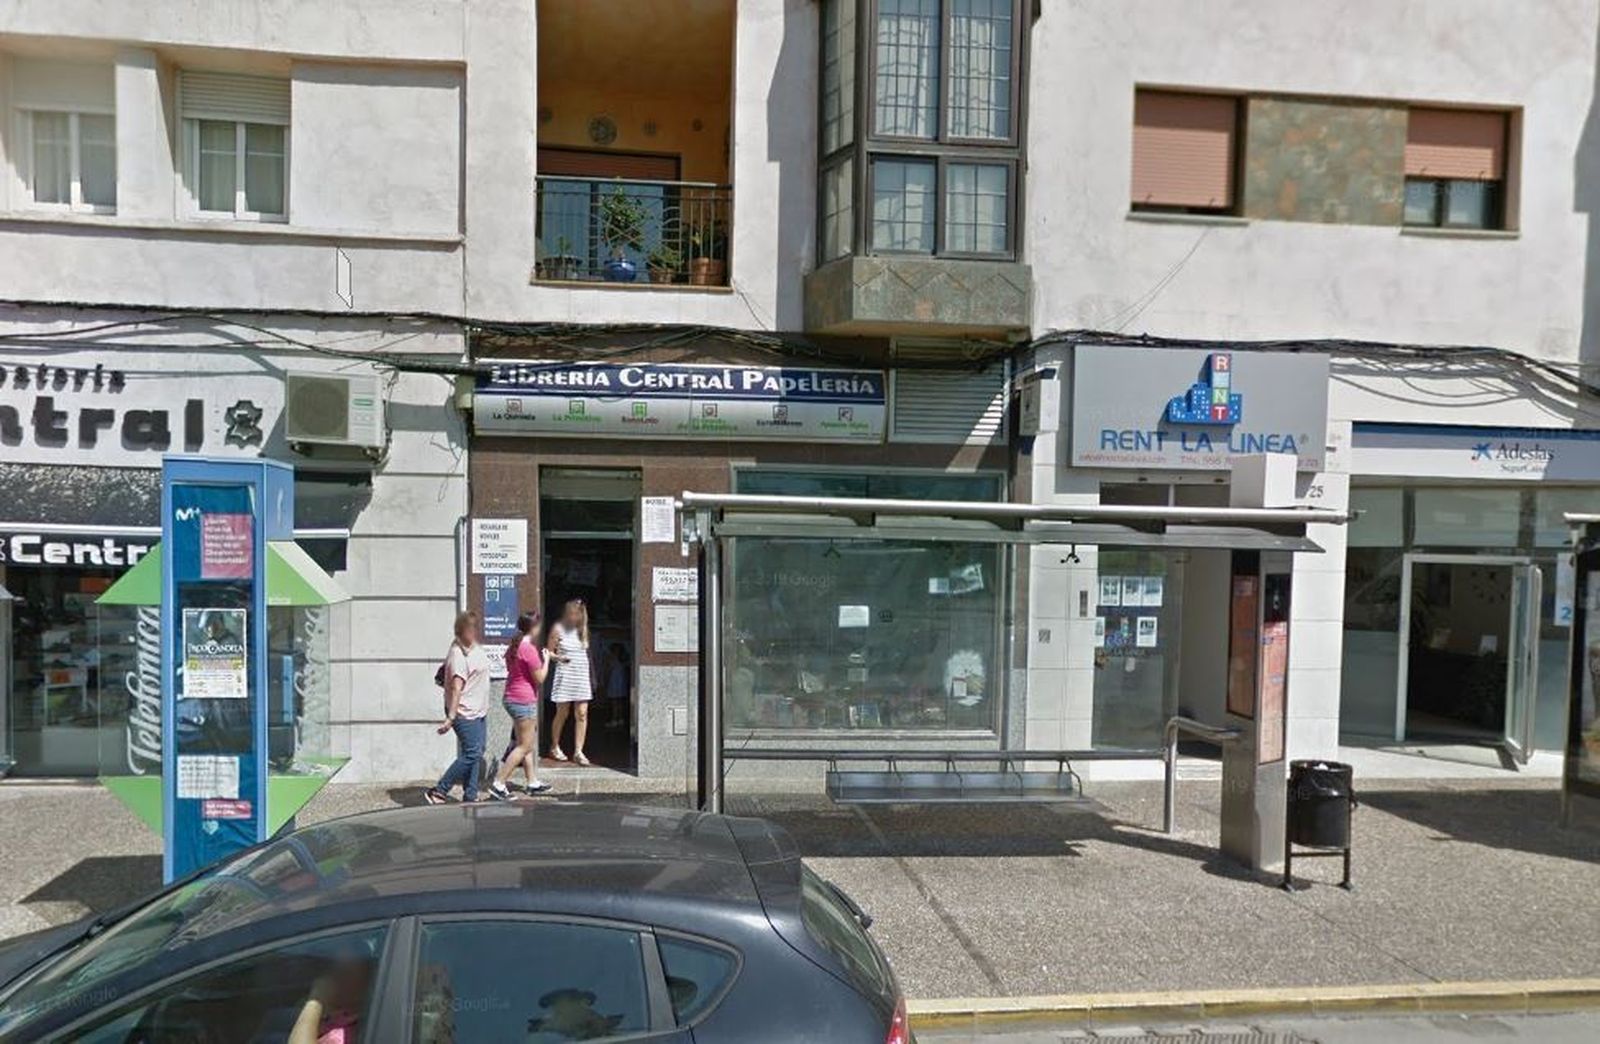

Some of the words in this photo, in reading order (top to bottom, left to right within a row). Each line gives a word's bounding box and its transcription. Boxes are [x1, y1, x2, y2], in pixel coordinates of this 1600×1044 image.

[1100, 428, 1169, 452] RENT
[1181, 431, 1214, 453] LA
[1228, 432, 1299, 455] LINEA
[1495, 442, 1555, 461] Adeslas
[1308, 485, 1324, 498] 25
[10, 534, 158, 566] Centr
